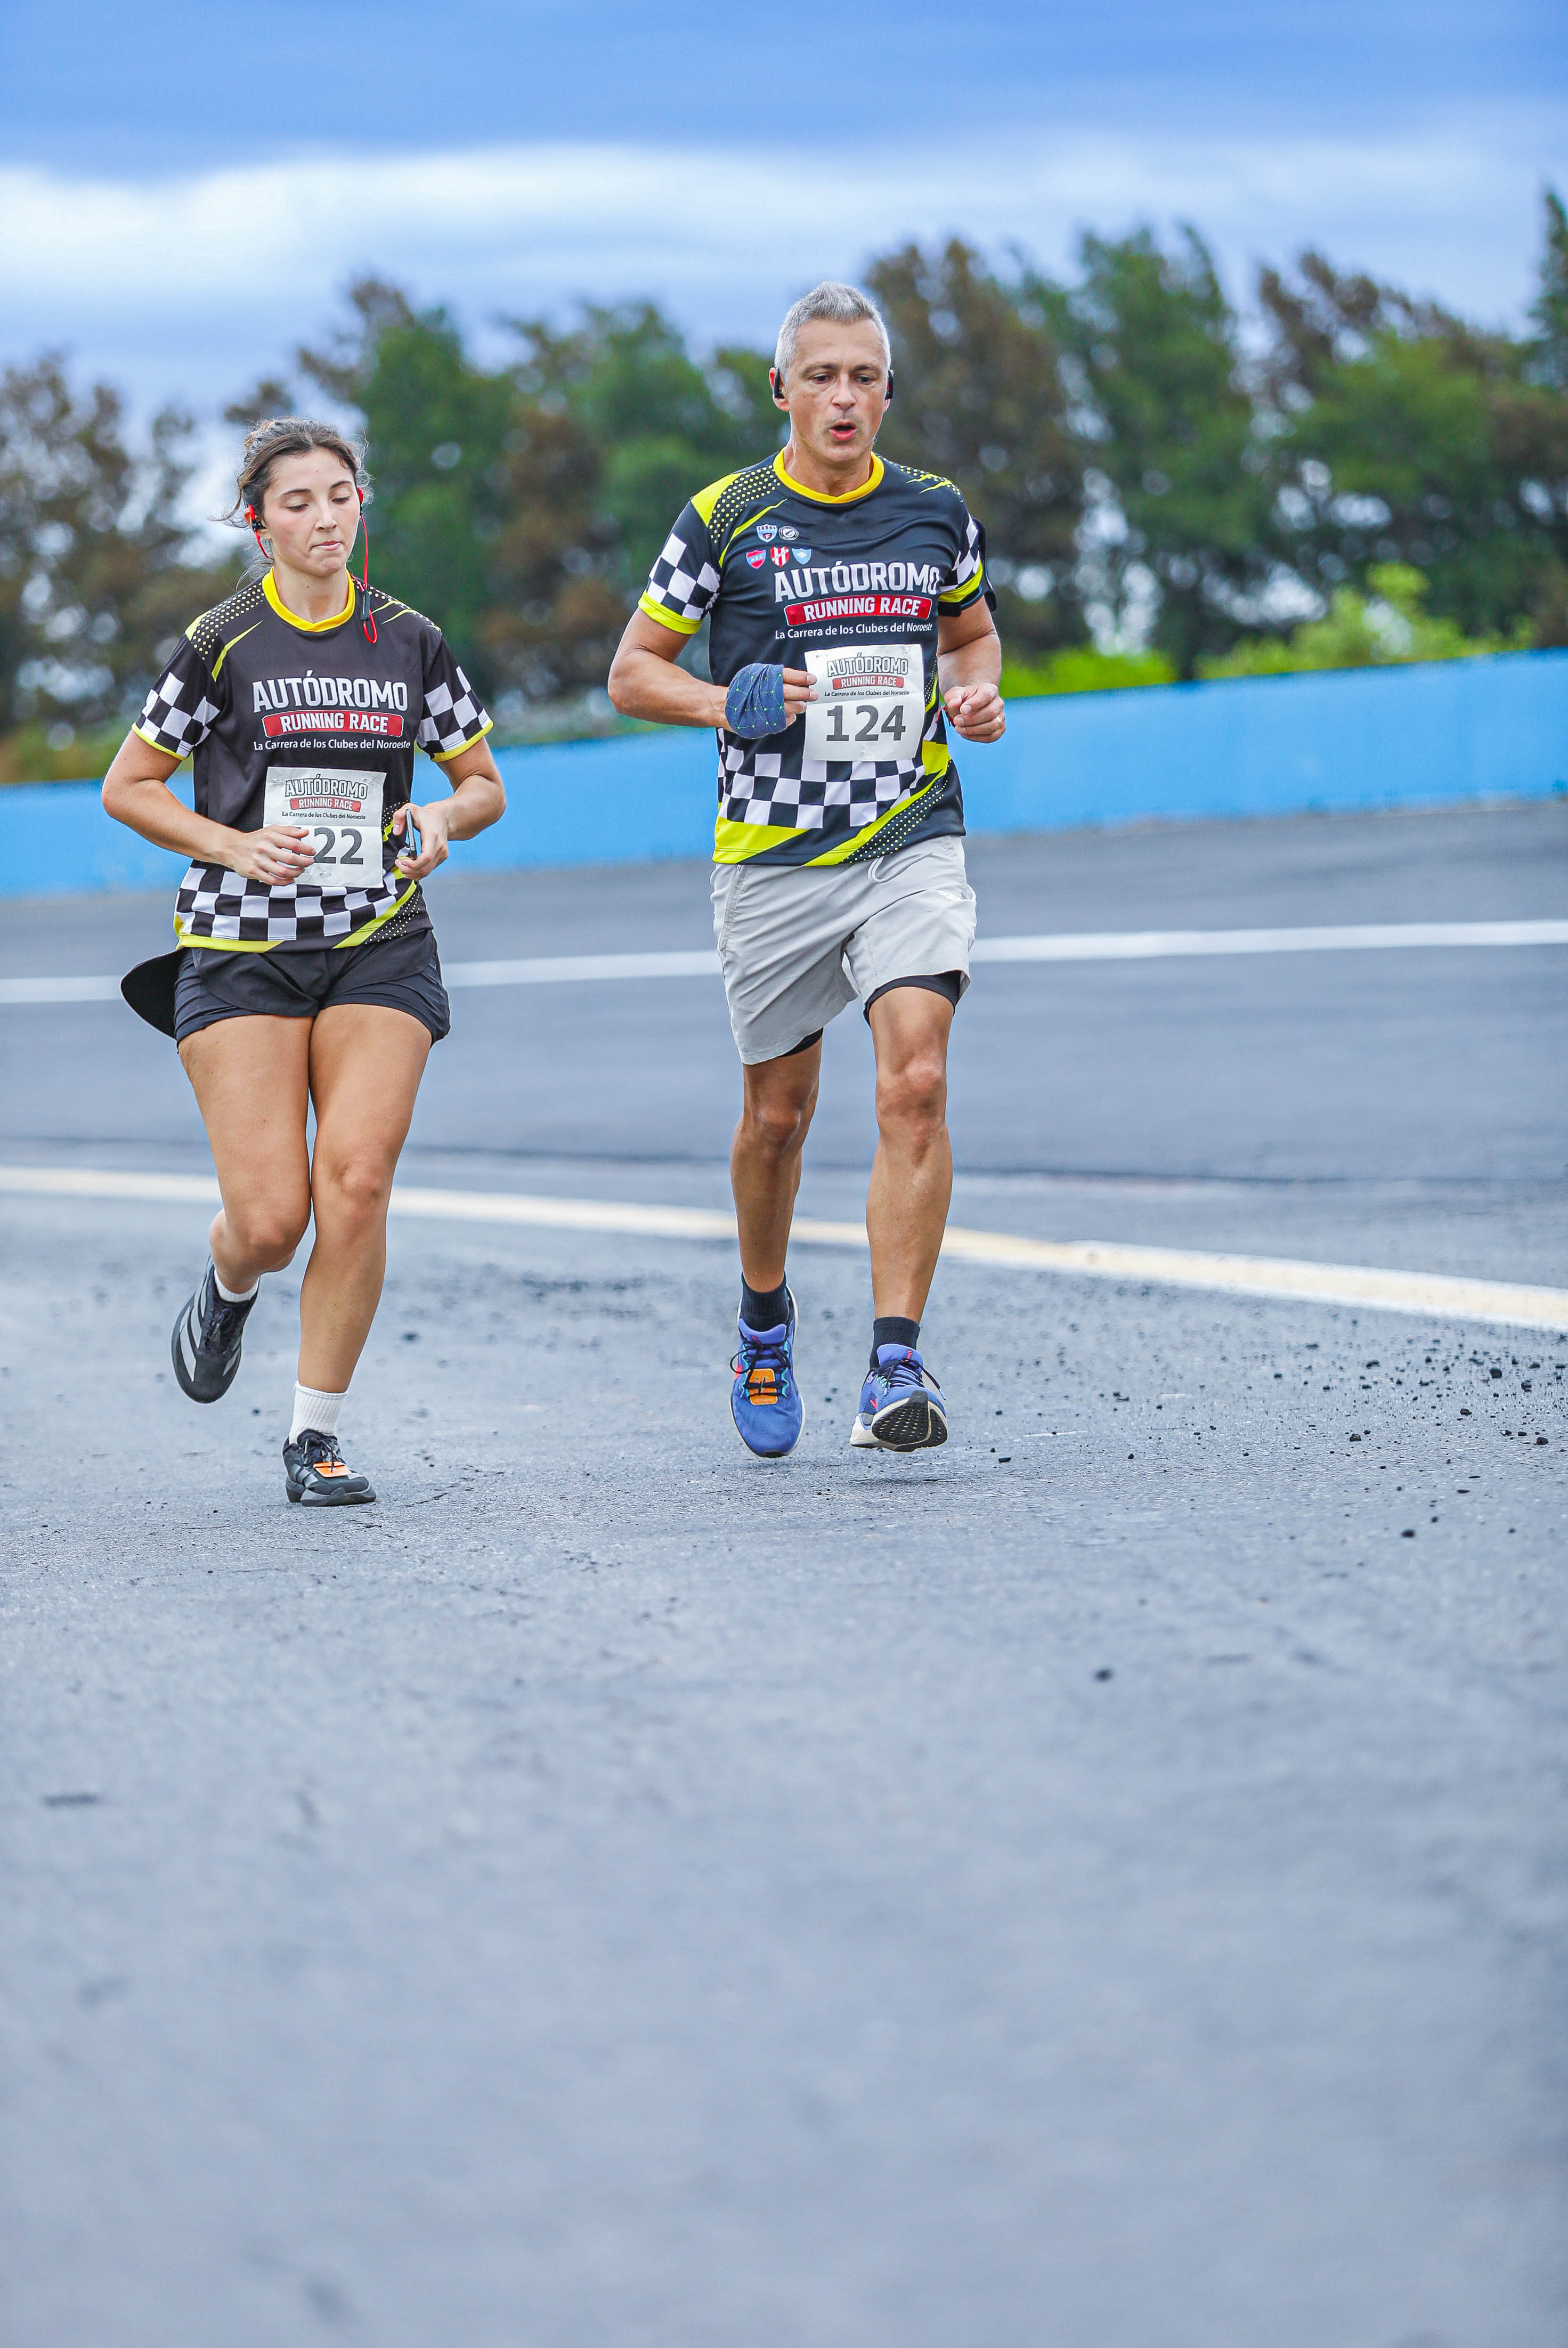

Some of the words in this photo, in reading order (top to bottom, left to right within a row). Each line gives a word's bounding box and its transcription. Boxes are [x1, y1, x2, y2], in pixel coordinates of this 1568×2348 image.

[774, 560, 940, 603] AUTÓDROMO
[803, 597, 875, 621] RUNNING
[880, 597, 922, 616] RACE
[775, 630, 785, 640] La
[787, 629, 823, 639] Carrera
[825, 625, 838, 636] de
[839, 624, 854, 635] los
[856, 623, 888, 633] Clubes
[890, 622, 905, 632] del
[907, 623, 932, 632] Noroeste
[826, 652, 908, 678] AUTÓDROMO
[252, 670, 409, 713] AUTÓDROMO
[840, 676, 876, 688] RUNNING
[878, 676, 897, 686] RACE
[279, 712, 345, 733] RUNNING
[349, 713, 389, 733] RACE
[826, 705, 906, 742] 124
[254, 741, 263, 751] La
[265, 740, 298, 750] Carrera
[300, 738, 312, 749] de
[313, 738, 326, 748] los
[328, 739, 359, 749] Clubes
[360, 740, 374, 749] del
[376, 740, 411, 749] Noroeste
[285, 774, 368, 799] AUTÓDROMO
[298, 798, 332, 808] RUNNING
[334, 799, 353, 810] RACE
[291, 826, 363, 865] 22
